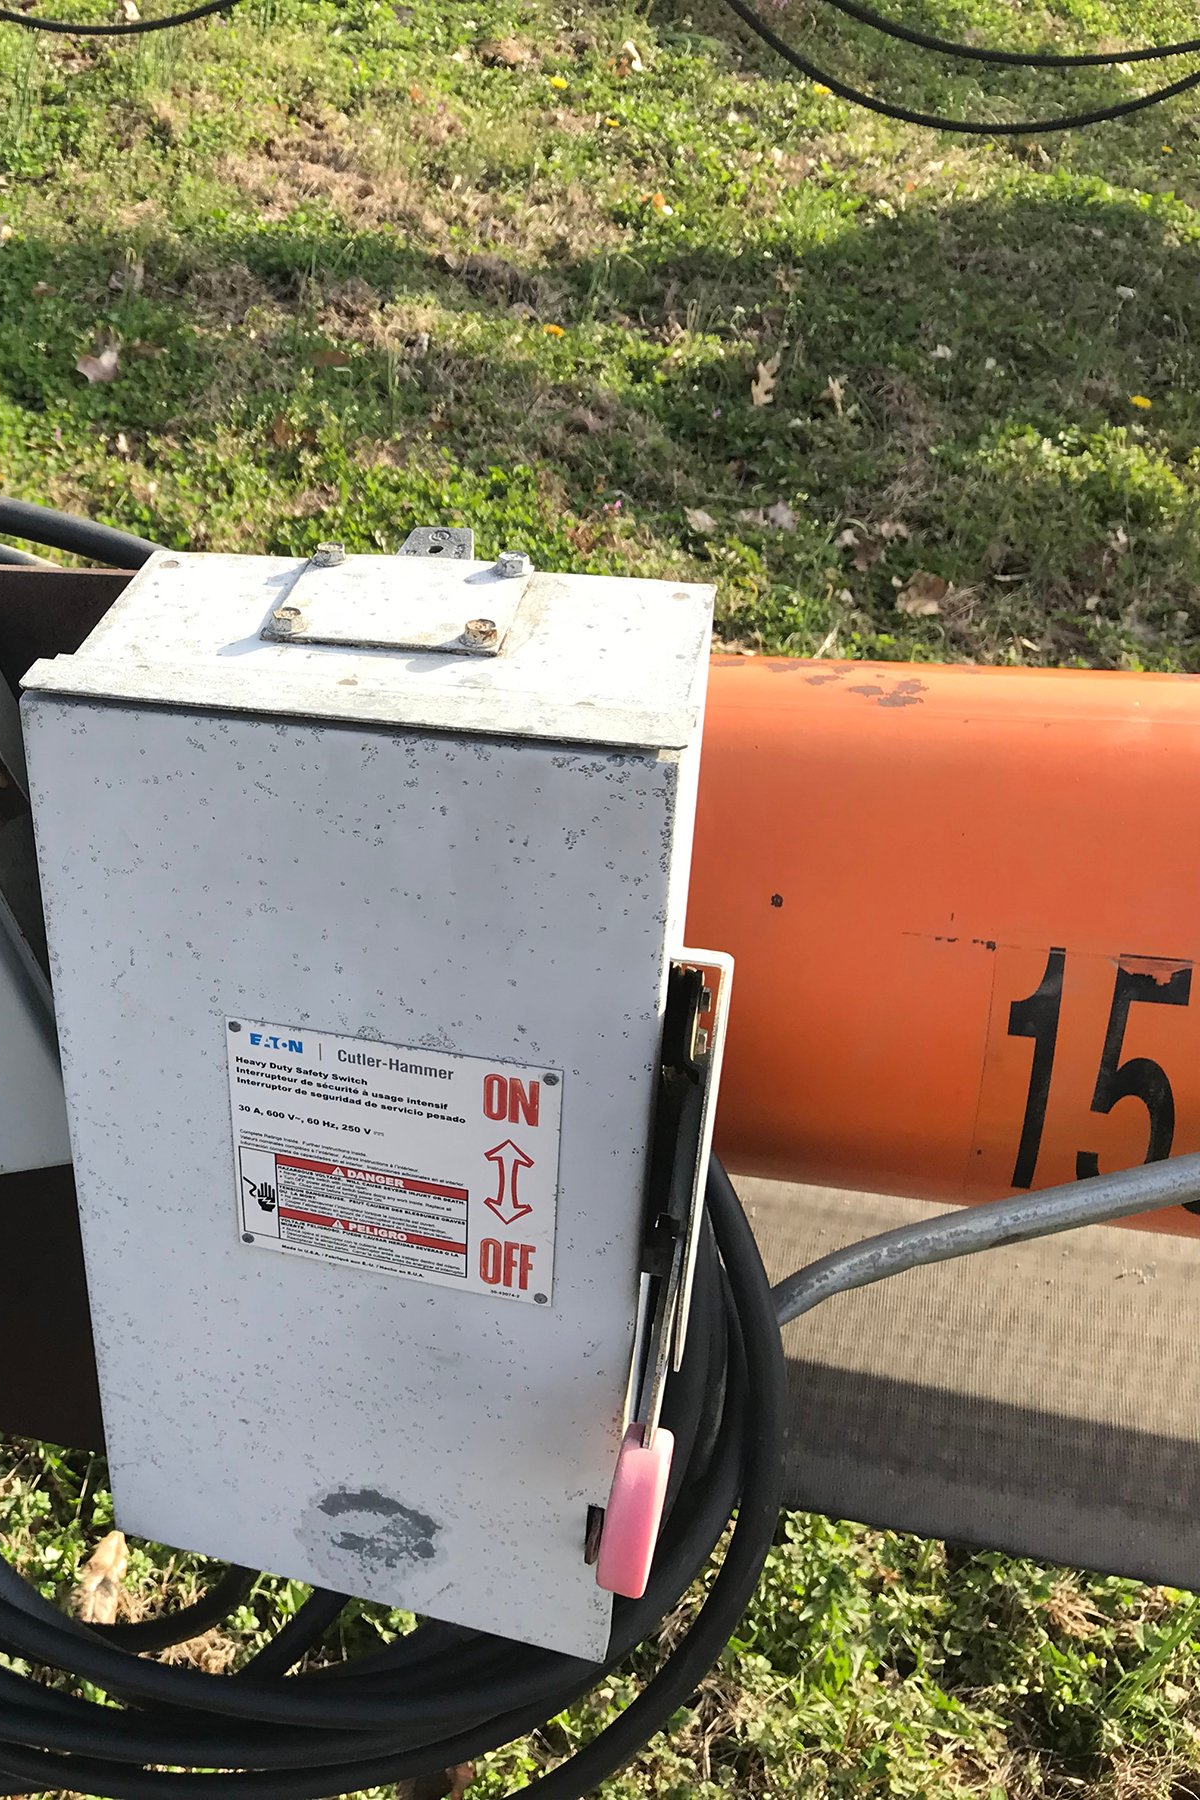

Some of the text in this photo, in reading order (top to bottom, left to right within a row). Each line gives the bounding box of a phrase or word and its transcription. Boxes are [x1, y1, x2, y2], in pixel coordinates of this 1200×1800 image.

[235, 1055, 367, 1086] Heavy Duty Safety Switch
[249, 1032, 454, 1081] EATON Cutler-Hammer
[235, 1065, 448, 1110] Interrupteur de sécurité à usage intensif
[236, 1075, 466, 1125] Interruptor de seguridad de servicio pesado
[481, 1071, 541, 1128] ON
[1007, 947, 1200, 1216] 15
[238, 1103, 250, 1113] 30
[252, 1106, 263, 1116] A,
[265, 1109, 285, 1119] 600
[306, 1116, 319, 1126] 60
[322, 1119, 338, 1130] Hz,
[341, 1123, 360, 1133] 250
[346, 1168, 404, 1188] DANGER
[347, 1221, 408, 1242] PELIGRO
[478, 1234, 537, 1293] OFF
